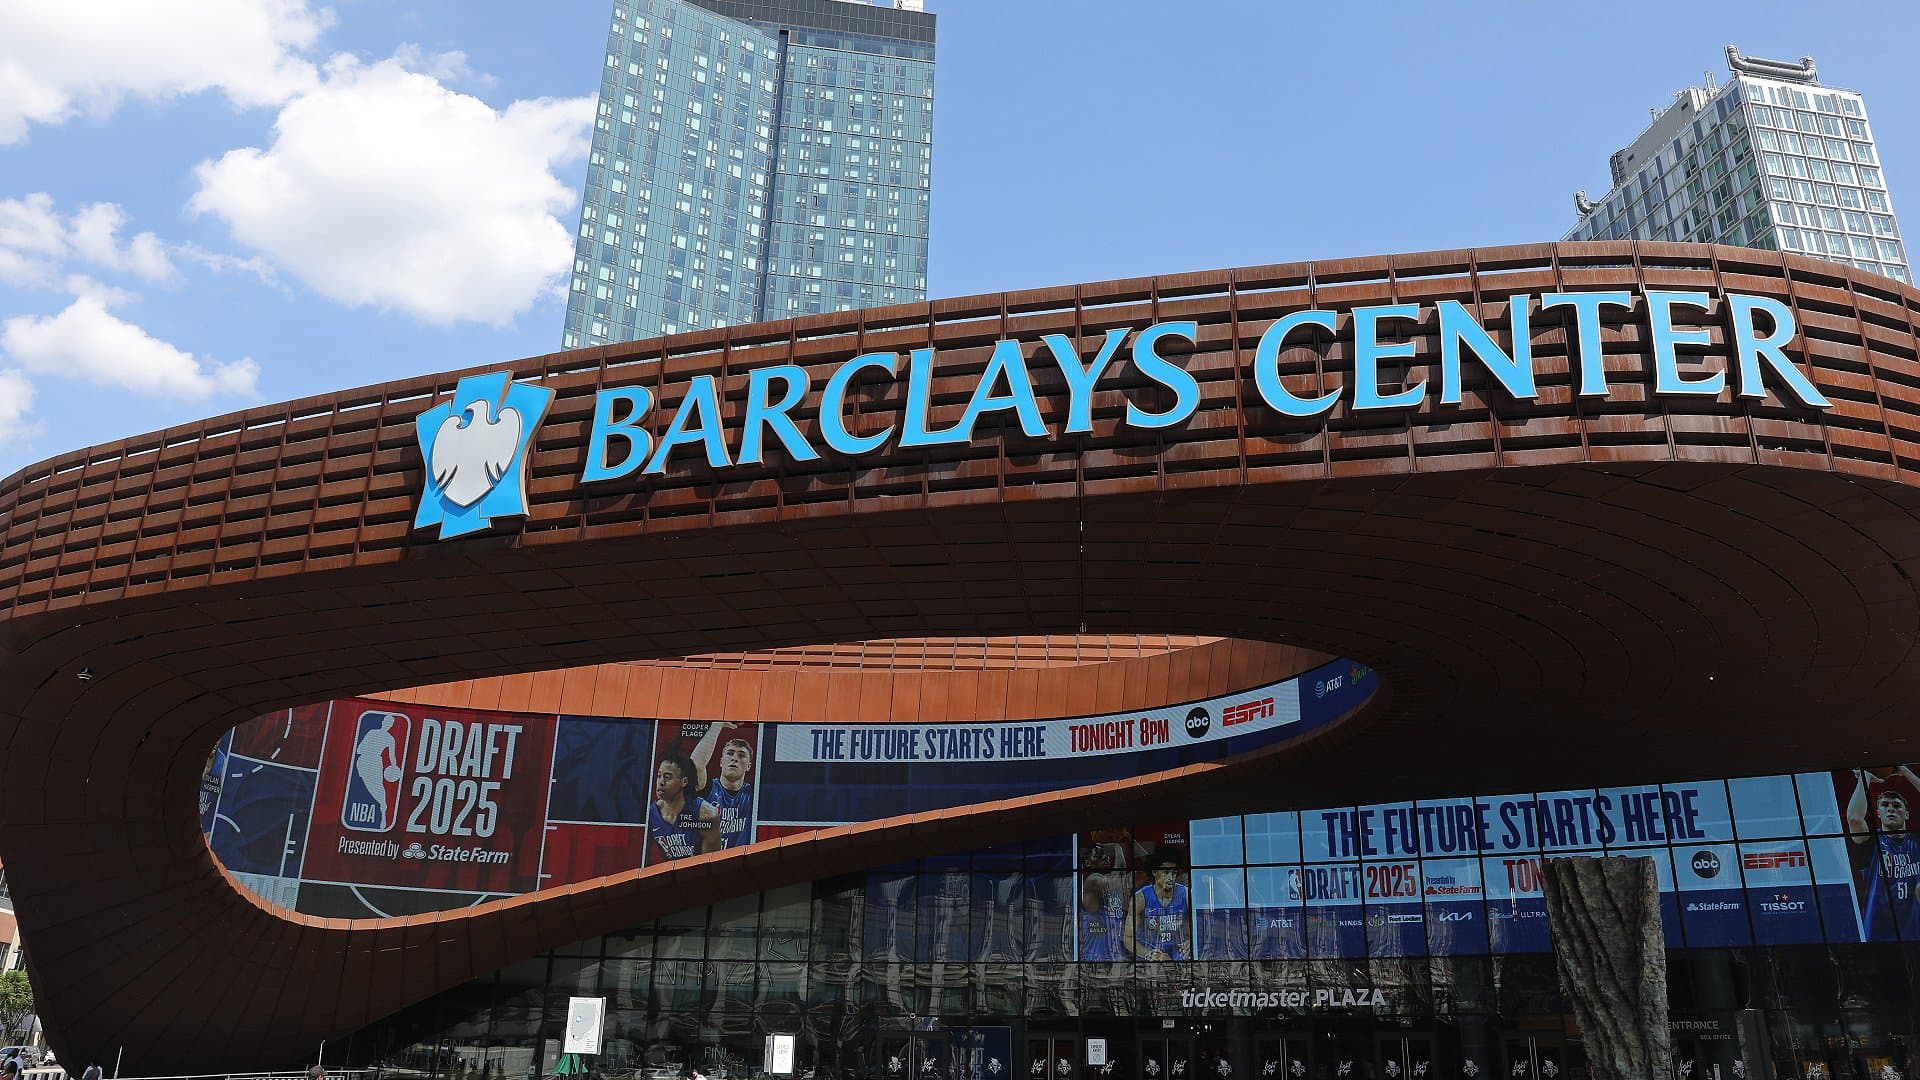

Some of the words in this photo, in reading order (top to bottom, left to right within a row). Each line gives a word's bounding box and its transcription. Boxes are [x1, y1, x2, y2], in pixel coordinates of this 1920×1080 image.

[580, 320, 1200, 483] BARCLAYS
[1254, 291, 1835, 418] CENTER
[1326, 675, 1342, 693] AT&T
[682, 723, 709, 731] COOPER
[811, 729, 846, 760] THE
[850, 729, 920, 760] FUTURE
[925, 727, 995, 760] STARTS
[1001, 726, 1047, 758] HERE
[1069, 719, 1135, 753] TONIGHT
[1140, 718, 1169, 747] 8PM
[1186, 712, 1209, 729] abc
[1222, 697, 1274, 727] ESPN
[415, 719, 523, 779] DRAFT
[350, 802, 375, 823] NBA
[406, 776, 501, 838] 2025
[679, 821, 712, 829] JOHNSON
[1322, 809, 1377, 858] THE
[1383, 802, 1494, 855] FUTURE
[1501, 795, 1616, 850] STARTS
[1621, 788, 1705, 844] HERE
[337, 836, 387, 857] Presented
[387, 840, 400, 859] by
[1693, 858, 1718, 870] abc
[1744, 851, 1805, 869] ESPN
[1304, 867, 1361, 900] DRAFT
[1367, 864, 1416, 898] 2025
[1897, 882, 1908, 900] 51
[1520, 911, 1547, 919] ULTRA
[1759, 901, 1805, 912] TISSOT
[1270, 918, 1294, 929] AT&T
[1161, 933, 1172, 942] 23
[633, 961, 687, 985] FNI
[1181, 987, 1310, 1007] ticketmaster
[1315, 988, 1386, 1006] PLAZA
[1668, 1020, 1720, 1030] ENTRANCE
[705, 1046, 727, 1059] FINI
